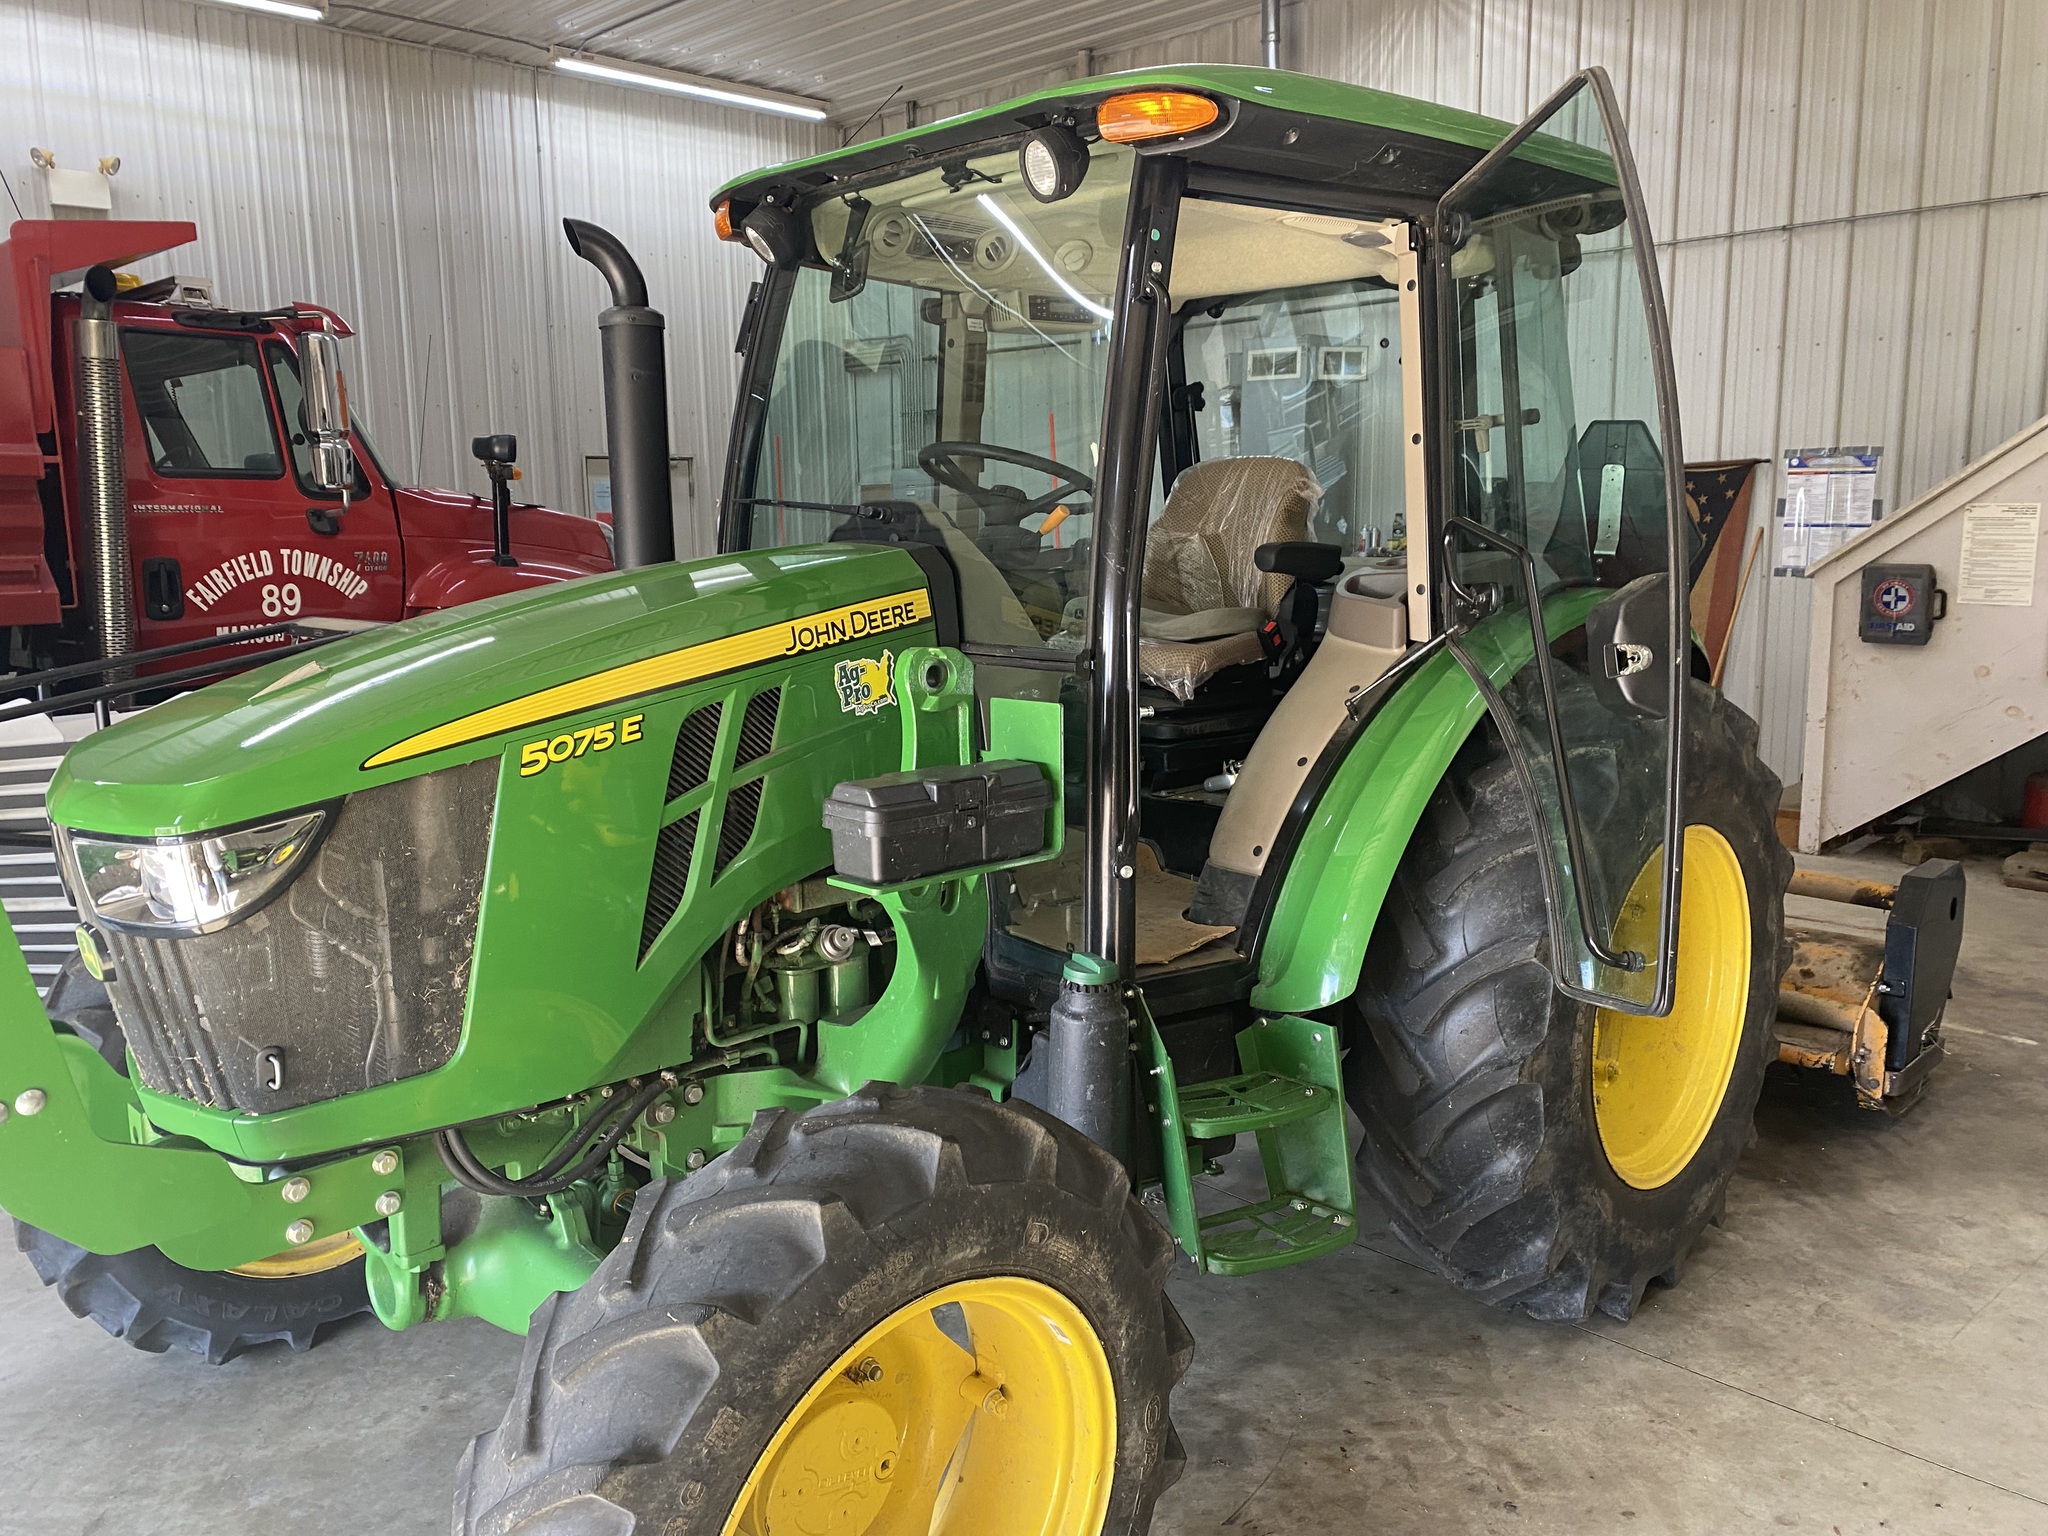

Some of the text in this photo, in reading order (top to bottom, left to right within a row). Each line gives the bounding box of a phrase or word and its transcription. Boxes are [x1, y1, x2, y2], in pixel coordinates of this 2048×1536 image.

[133, 504, 225, 513] INTERNATIONAL
[185, 548, 368, 612] FAIRFIELD TOWNSHIP
[261, 583, 302, 618] 89
[785, 601, 917, 652] JOHN DEERE
[1895, 622, 1916, 631] AID
[838, 663, 866, 687] Ag-
[841, 683, 872, 707] Pro
[520, 713, 645, 777] 5075 E
